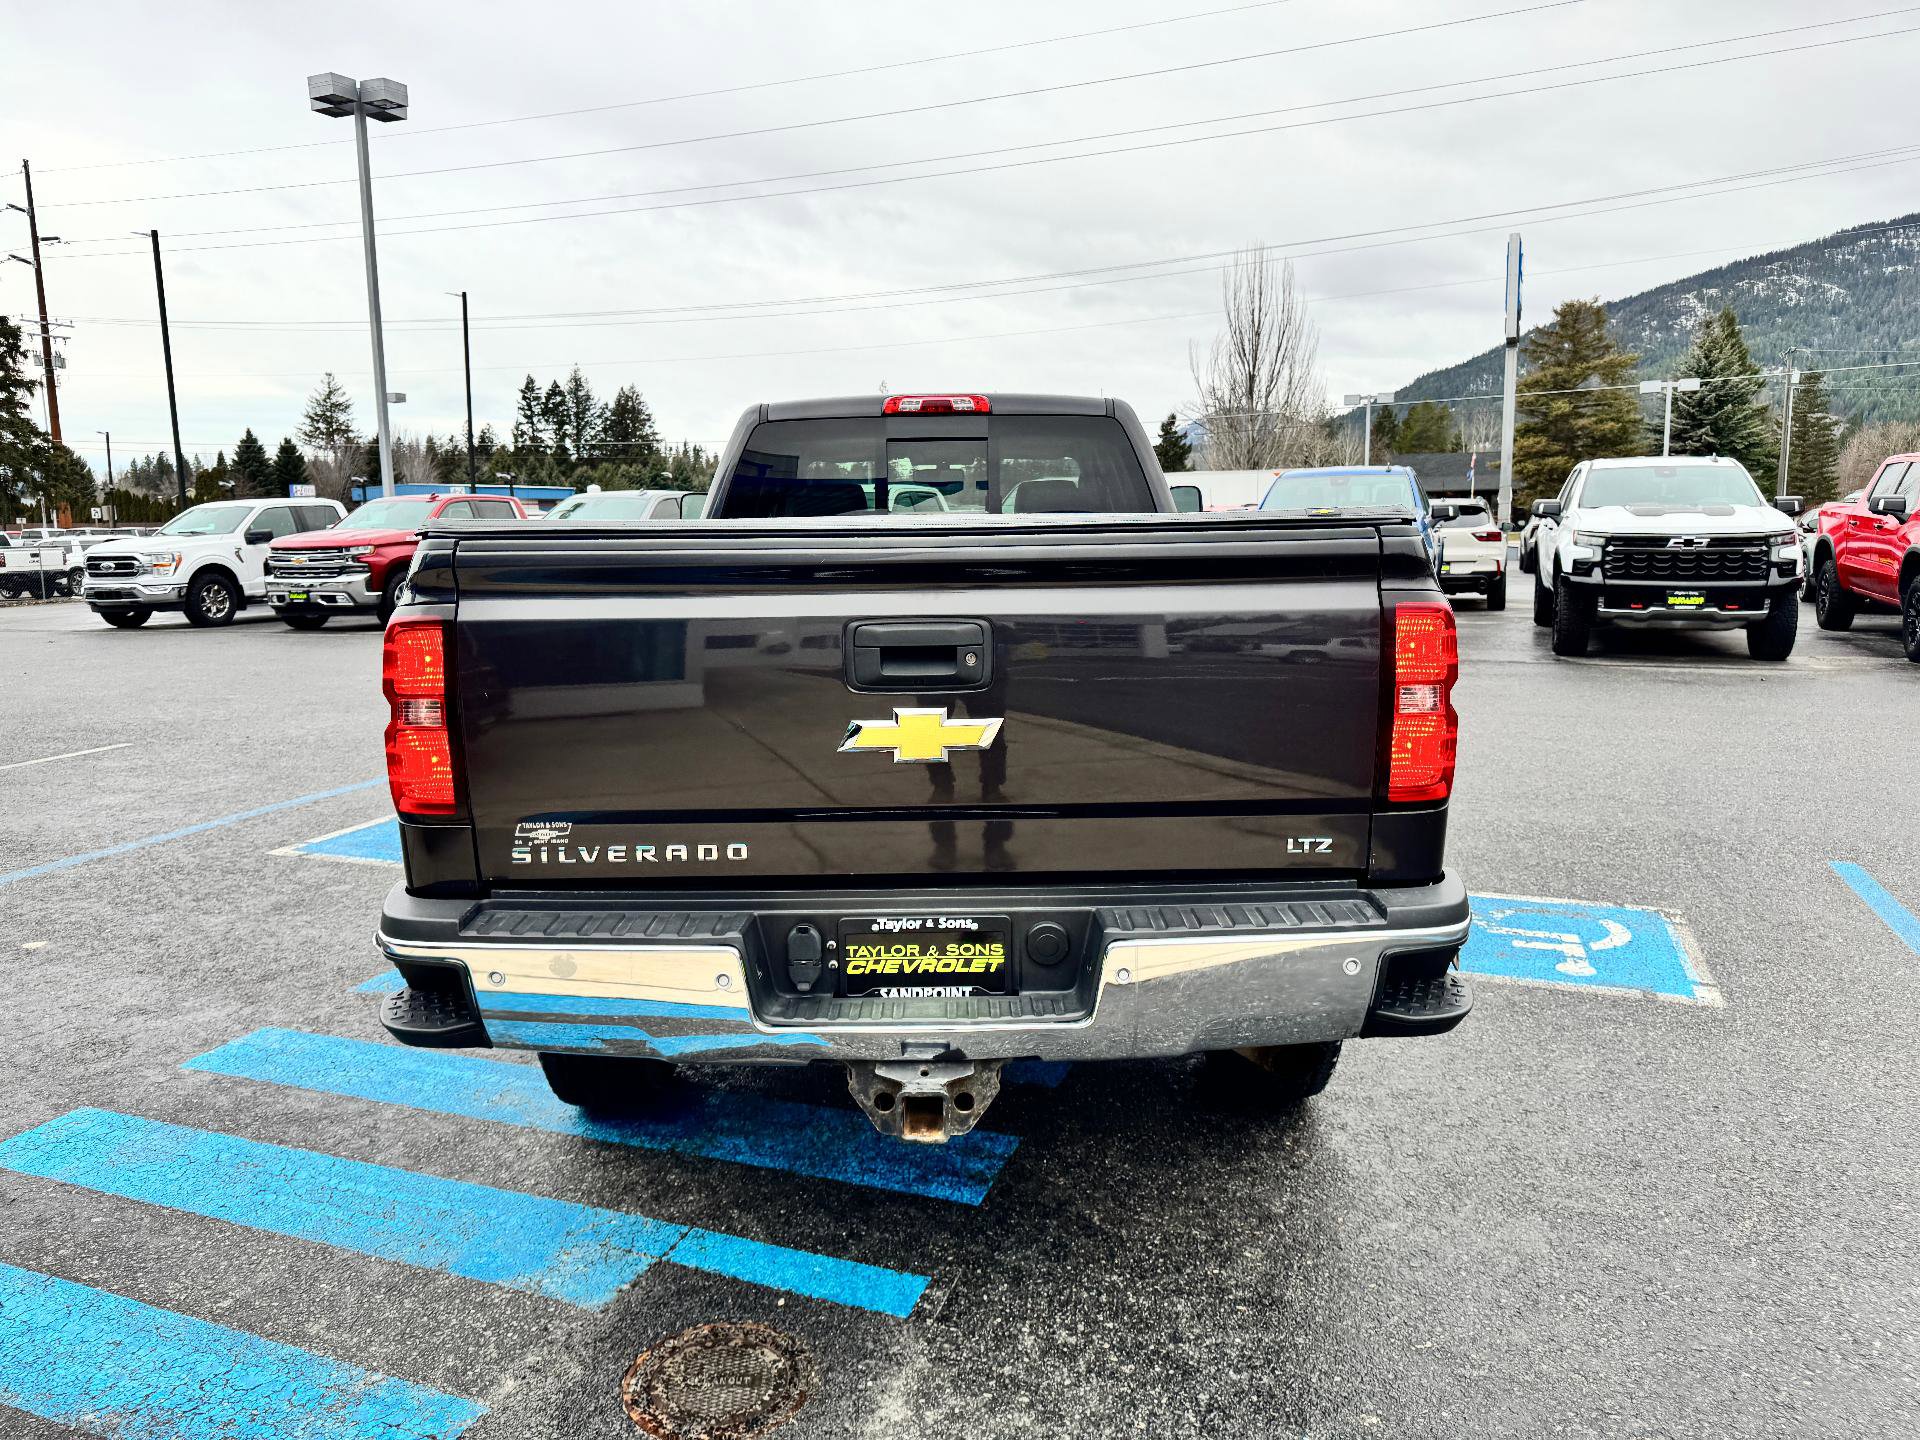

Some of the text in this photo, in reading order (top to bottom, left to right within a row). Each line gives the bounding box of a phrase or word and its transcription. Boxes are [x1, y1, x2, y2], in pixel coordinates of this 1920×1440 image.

[511, 843, 749, 864] SILVERADO
[1286, 837, 1333, 854] LTZ
[876, 917, 974, 933] Taylor & Sons
[845, 943, 1004, 958] TAYLOR & SONS
[846, 958, 1005, 975] CHEVROLET
[879, 986, 974, 998] SANDPOINT
